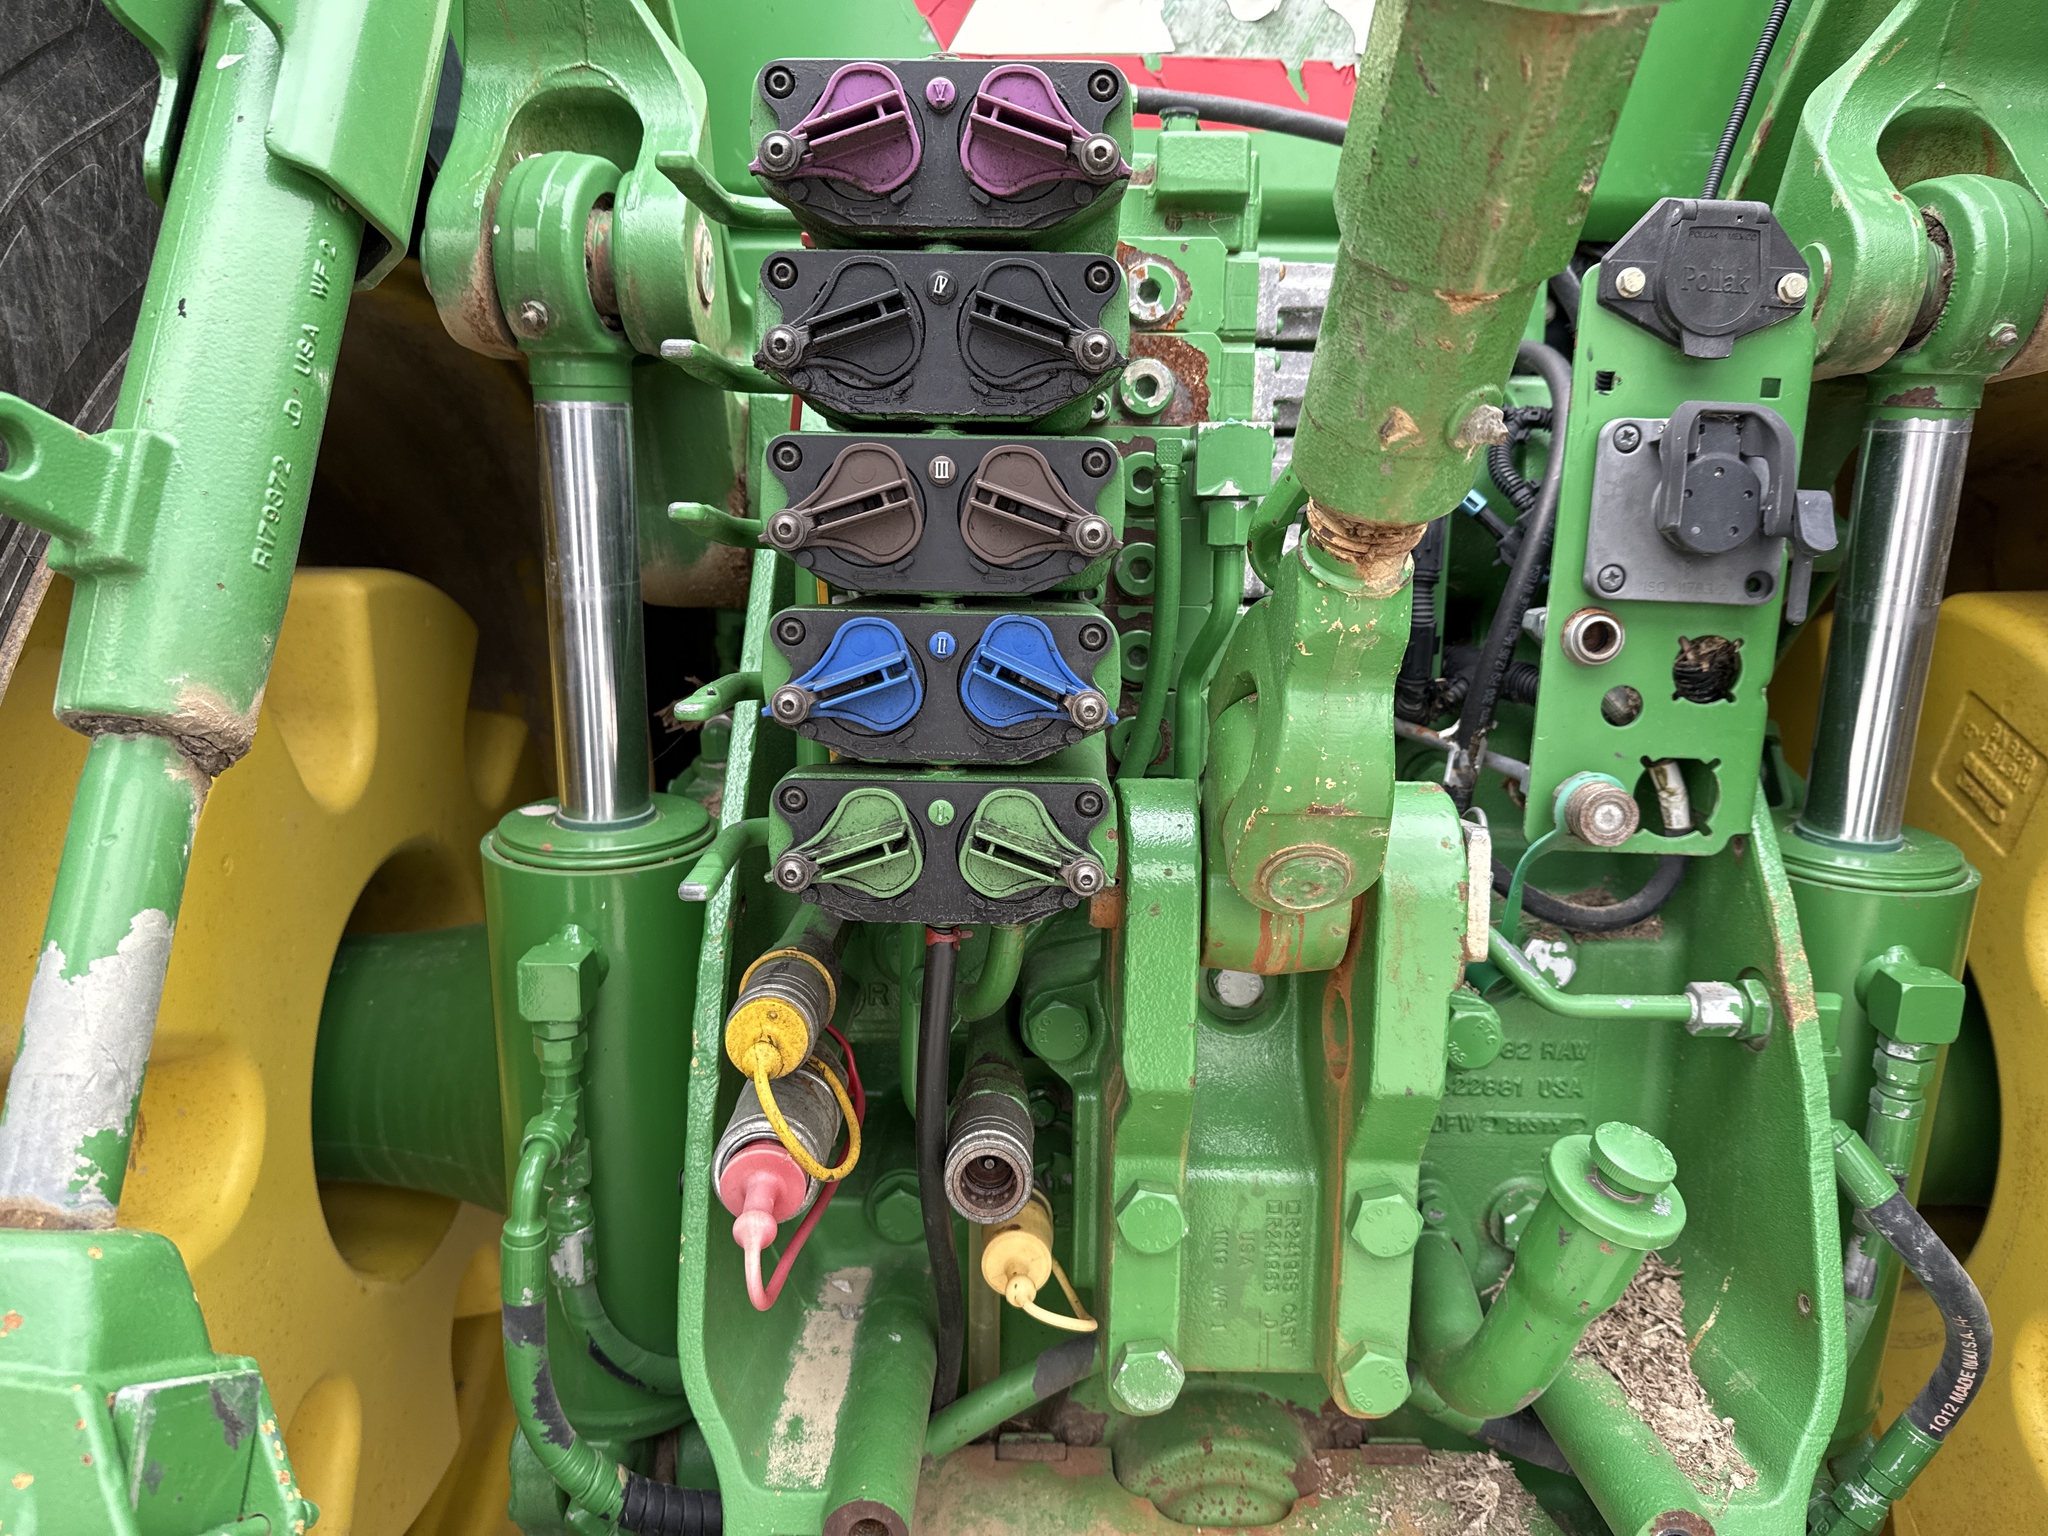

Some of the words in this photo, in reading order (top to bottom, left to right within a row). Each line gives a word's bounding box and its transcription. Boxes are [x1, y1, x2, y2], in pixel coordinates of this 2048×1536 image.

[932, 82, 948, 103] V
[1687, 229, 1720, 240] POLLAK
[1681, 265, 1751, 295] Pollak
[293, 323, 320, 377] USA
[934, 460, 950, 479] III
[1529, 563, 1543, 585] USA
[1643, 580, 1667, 593] ISO
[937, 636, 948, 654] II
[1541, 1039, 1590, 1061] RAW
[1537, 1076, 1584, 1099] USA
[1238, 1231, 1255, 1268] USA
[1281, 1303, 1298, 1349] CAST
[1929, 1402, 1960, 1433] 1Q12
[1949, 1369, 1977, 1404] MADE
